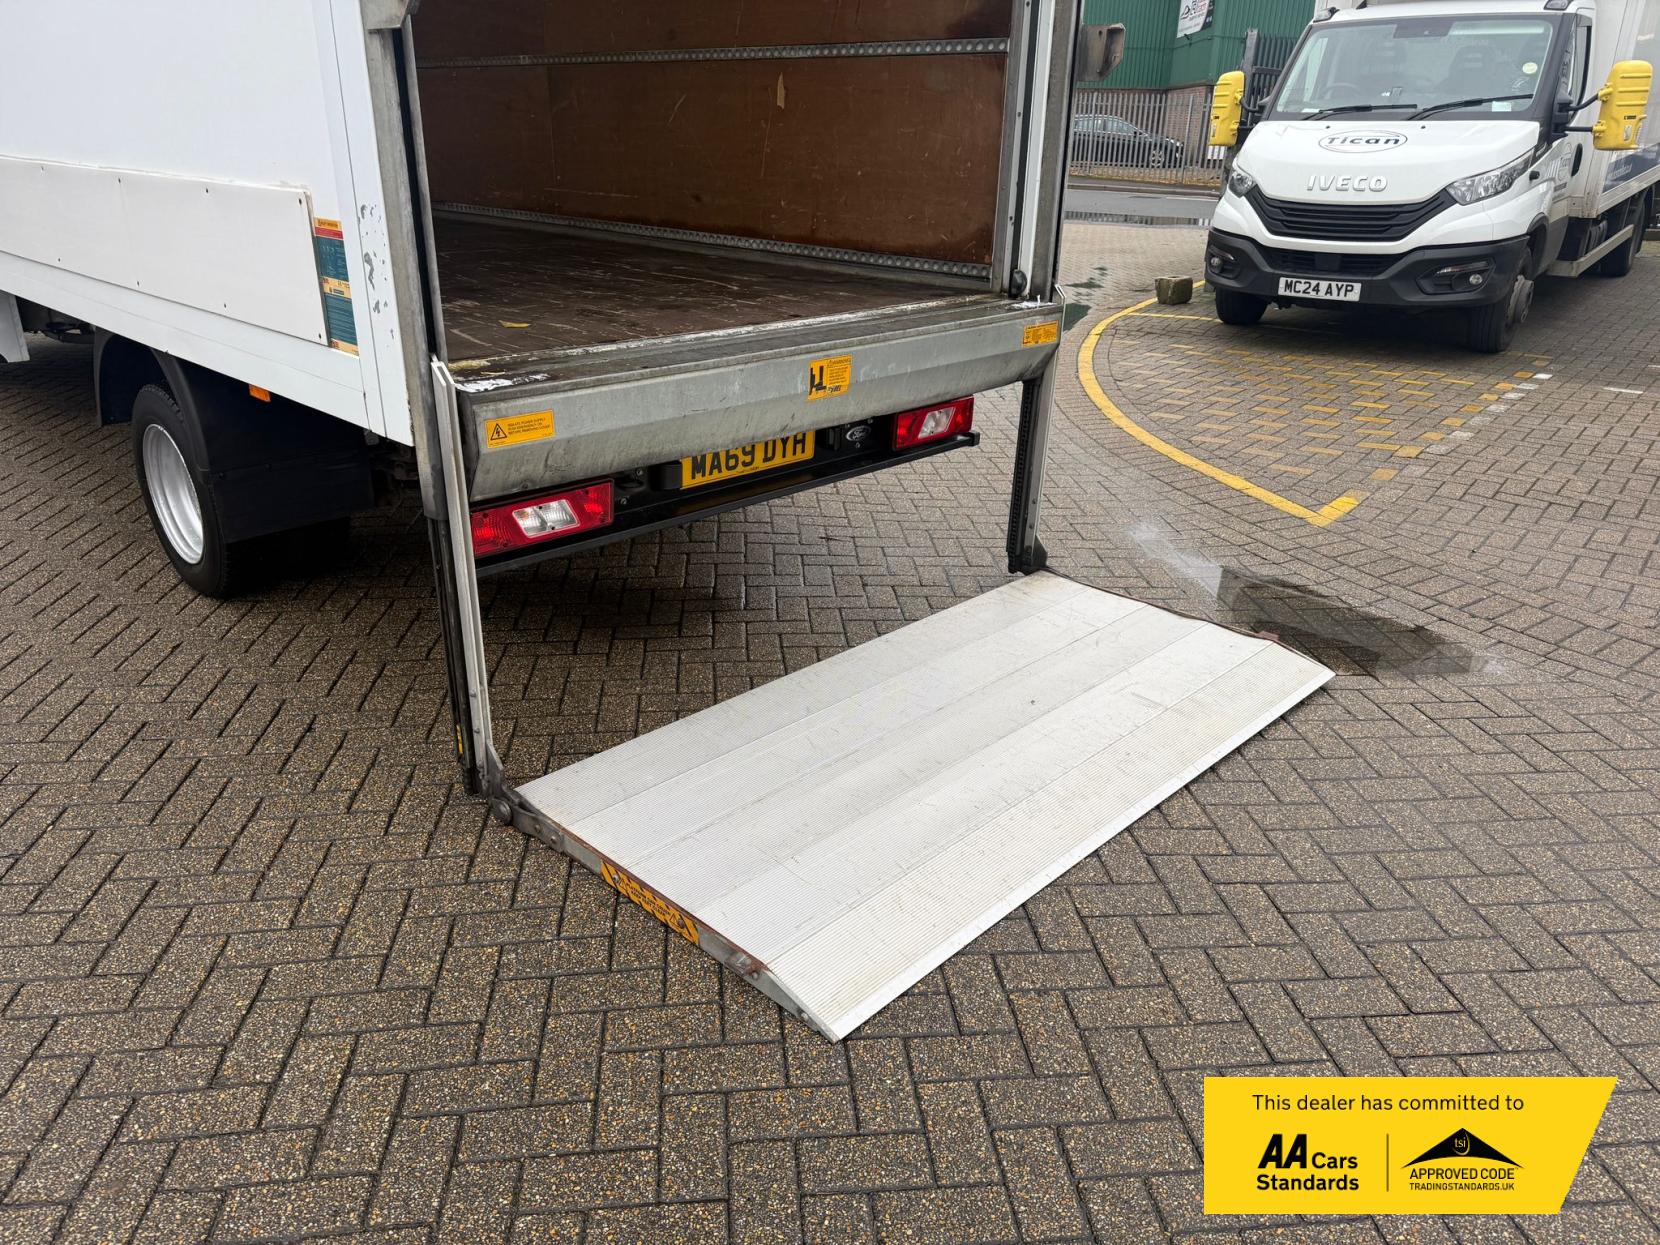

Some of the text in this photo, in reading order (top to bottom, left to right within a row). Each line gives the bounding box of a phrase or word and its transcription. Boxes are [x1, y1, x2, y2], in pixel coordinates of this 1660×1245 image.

[1328, 136, 1400, 145] Tican
[1306, 175, 1388, 193] IVECO
[1284, 279, 1355, 298] MC24 AYP
[692, 431, 807, 480] MA69 DYH
